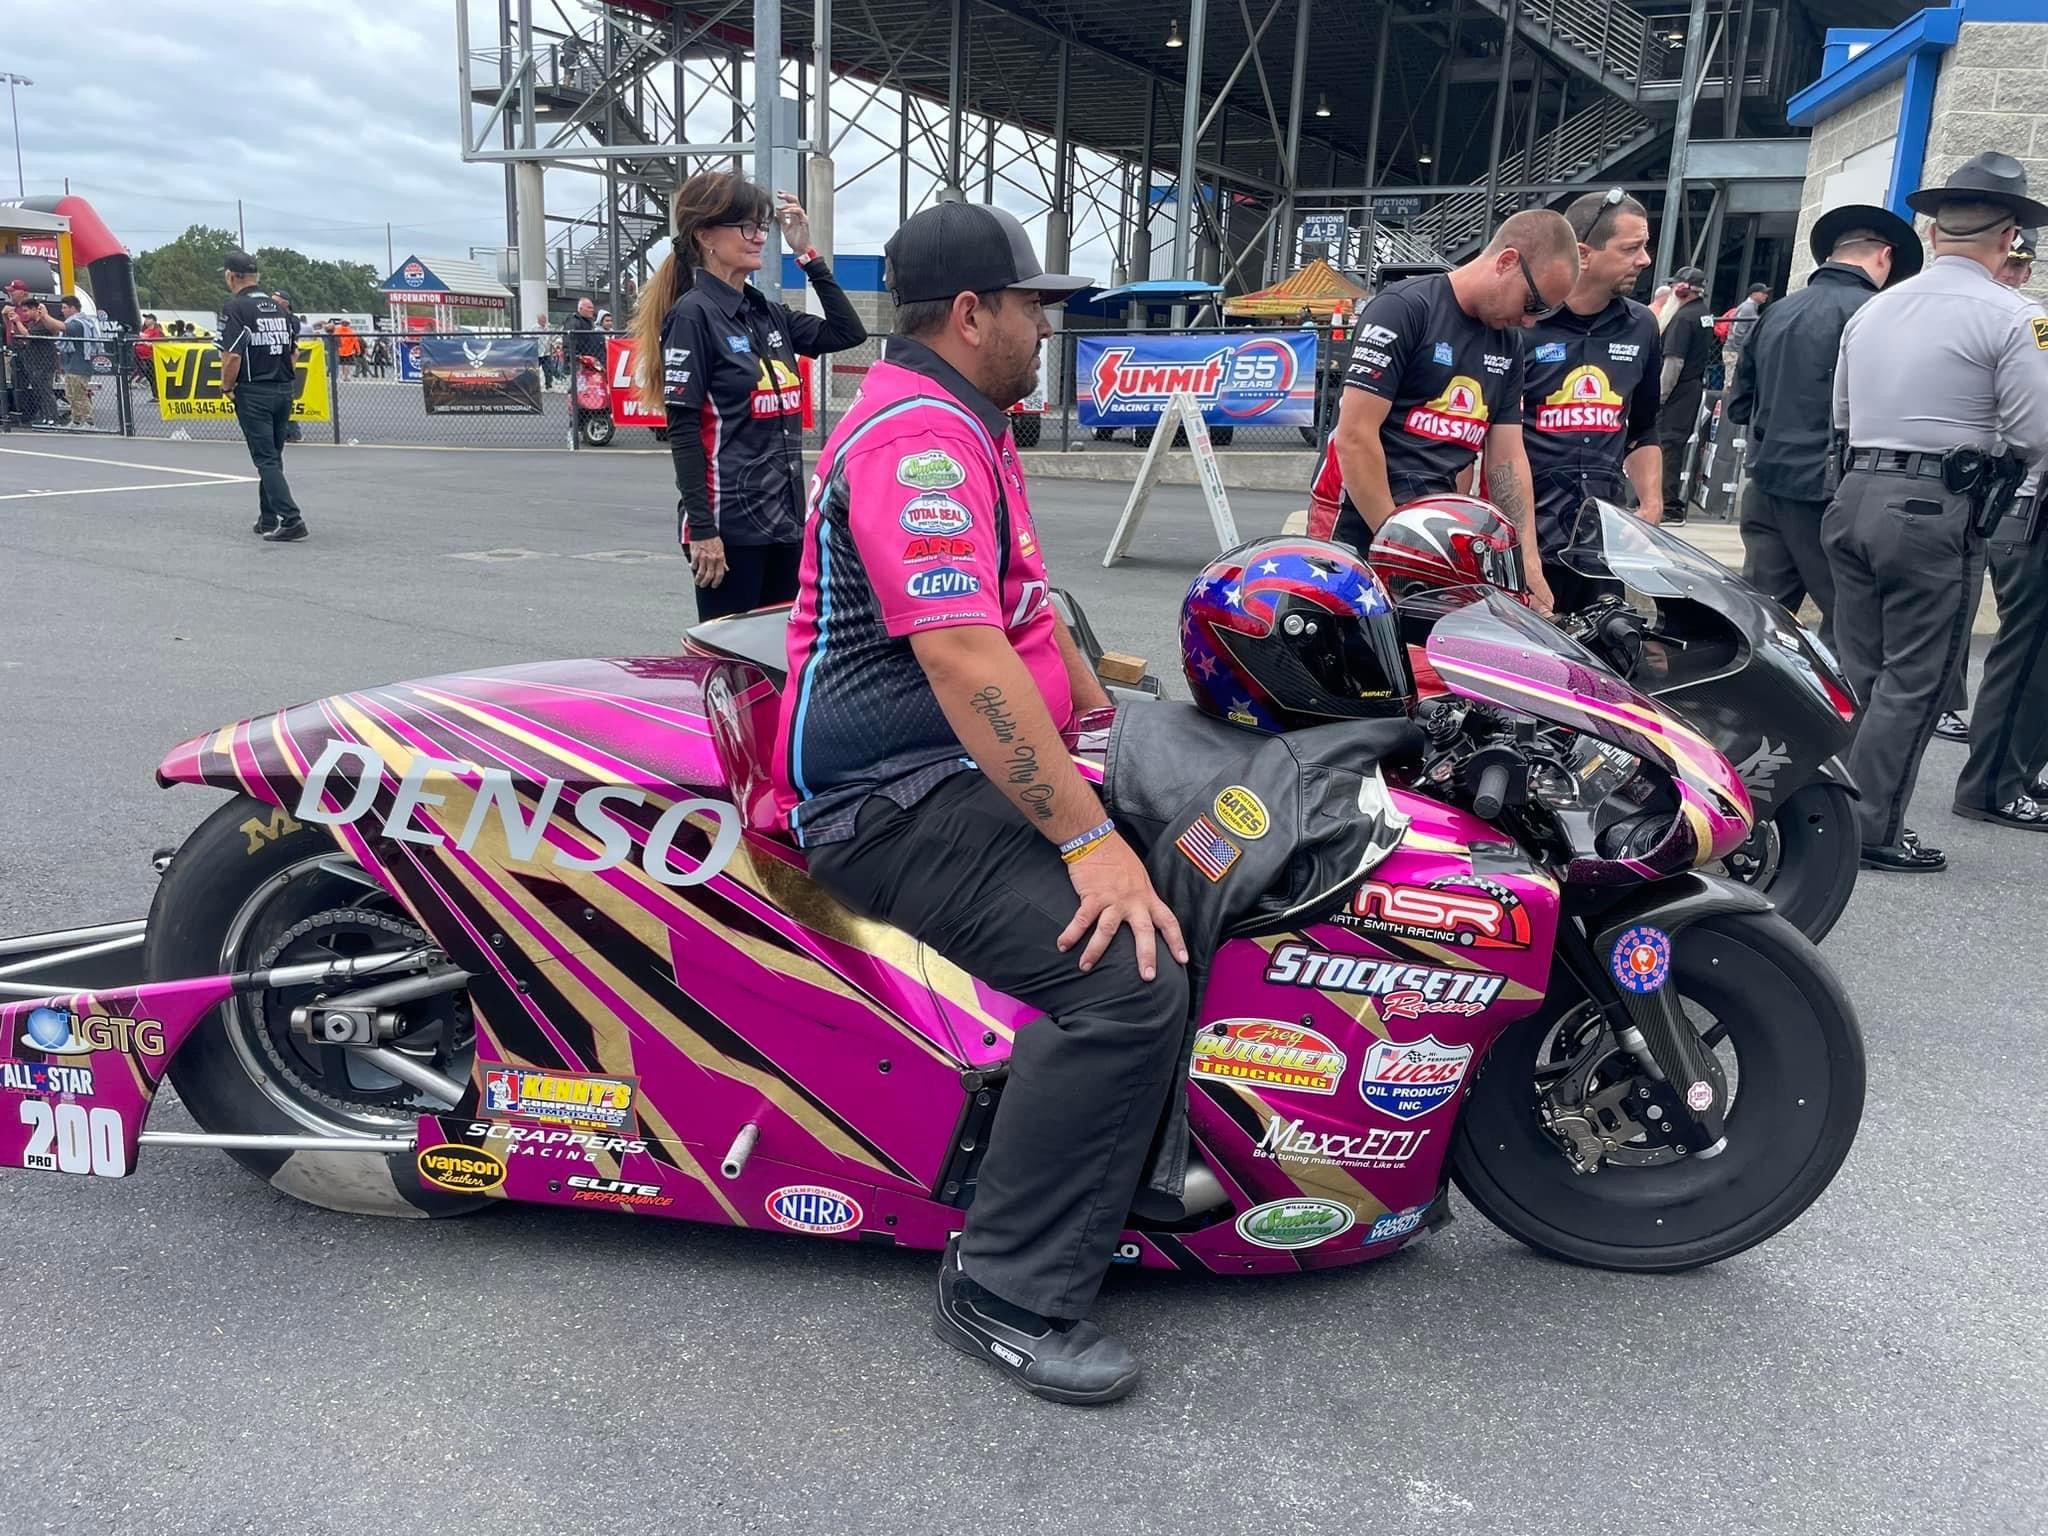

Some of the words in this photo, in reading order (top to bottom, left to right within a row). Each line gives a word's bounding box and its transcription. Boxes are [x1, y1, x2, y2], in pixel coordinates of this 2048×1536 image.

[1305, 215, 1344, 223] SECTIONS
[1310, 224, 1337, 236] A-B
[390, 293, 440, 302] INFORMATION
[445, 295, 503, 307] INFORMATION
[256, 318, 287, 331] STRUT
[1233, 356, 1278, 379] 55
[1232, 380, 1273, 388] YEARS
[1111, 403, 1149, 412] RACING
[908, 508, 939, 522] TOTAL
[940, 509, 963, 522] SEAL
[903, 537, 976, 559] ARP
[907, 573, 977, 597] CLEVITE
[1004, 746, 1040, 785] My
[295, 738, 742, 886] DENSO
[1019, 784, 1055, 821] Own
[1220, 792, 1262, 832] BATES
[1363, 918, 1404, 933] SMITH
[1407, 926, 1455, 942] RACING
[1268, 946, 1505, 1003] STOCKSETH
[1380, 990, 1487, 1020] Racing
[70, 1014, 165, 1056] IGTG
[1236, 1023, 1305, 1047] Greg
[1192, 1034, 1342, 1074] BUTCHER
[4, 1063, 37, 1089] ALL
[47, 1067, 94, 1095] STAR
[1200, 1061, 1328, 1089] TRUCKING
[1375, 1061, 1464, 1083] LUCAS
[521, 1074, 632, 1110] KENNY'S
[1366, 1086, 1388, 1096] OIL
[1392, 1084, 1456, 1097] PRODUCTS
[20, 1099, 126, 1178] 200
[466, 1123, 649, 1153] SCRAPPERS
[1256, 1115, 1431, 1160] MaxxECU
[28, 1155, 52, 1167] PRO
[505, 1144, 598, 1162] RACING
[1253, 1148, 1266, 1158] Be
[1278, 1152, 1309, 1165] tuning
[1311, 1157, 1371, 1169] mastermind.
[1373, 1160, 1391, 1169] Like
[425, 1154, 499, 1176] vanson
[438, 1171, 485, 1187] Leathers
[567, 1176, 660, 1196] ELITE
[572, 1191, 673, 1206] PERFORMANCE
[781, 1186, 846, 1201] CHAMPIONSHIP
[781, 1195, 848, 1224] NHRA
[781, 1217, 805, 1230] DRAG
[810, 1223, 848, 1232] RACING
[1371, 1216, 1421, 1240] WORLD
